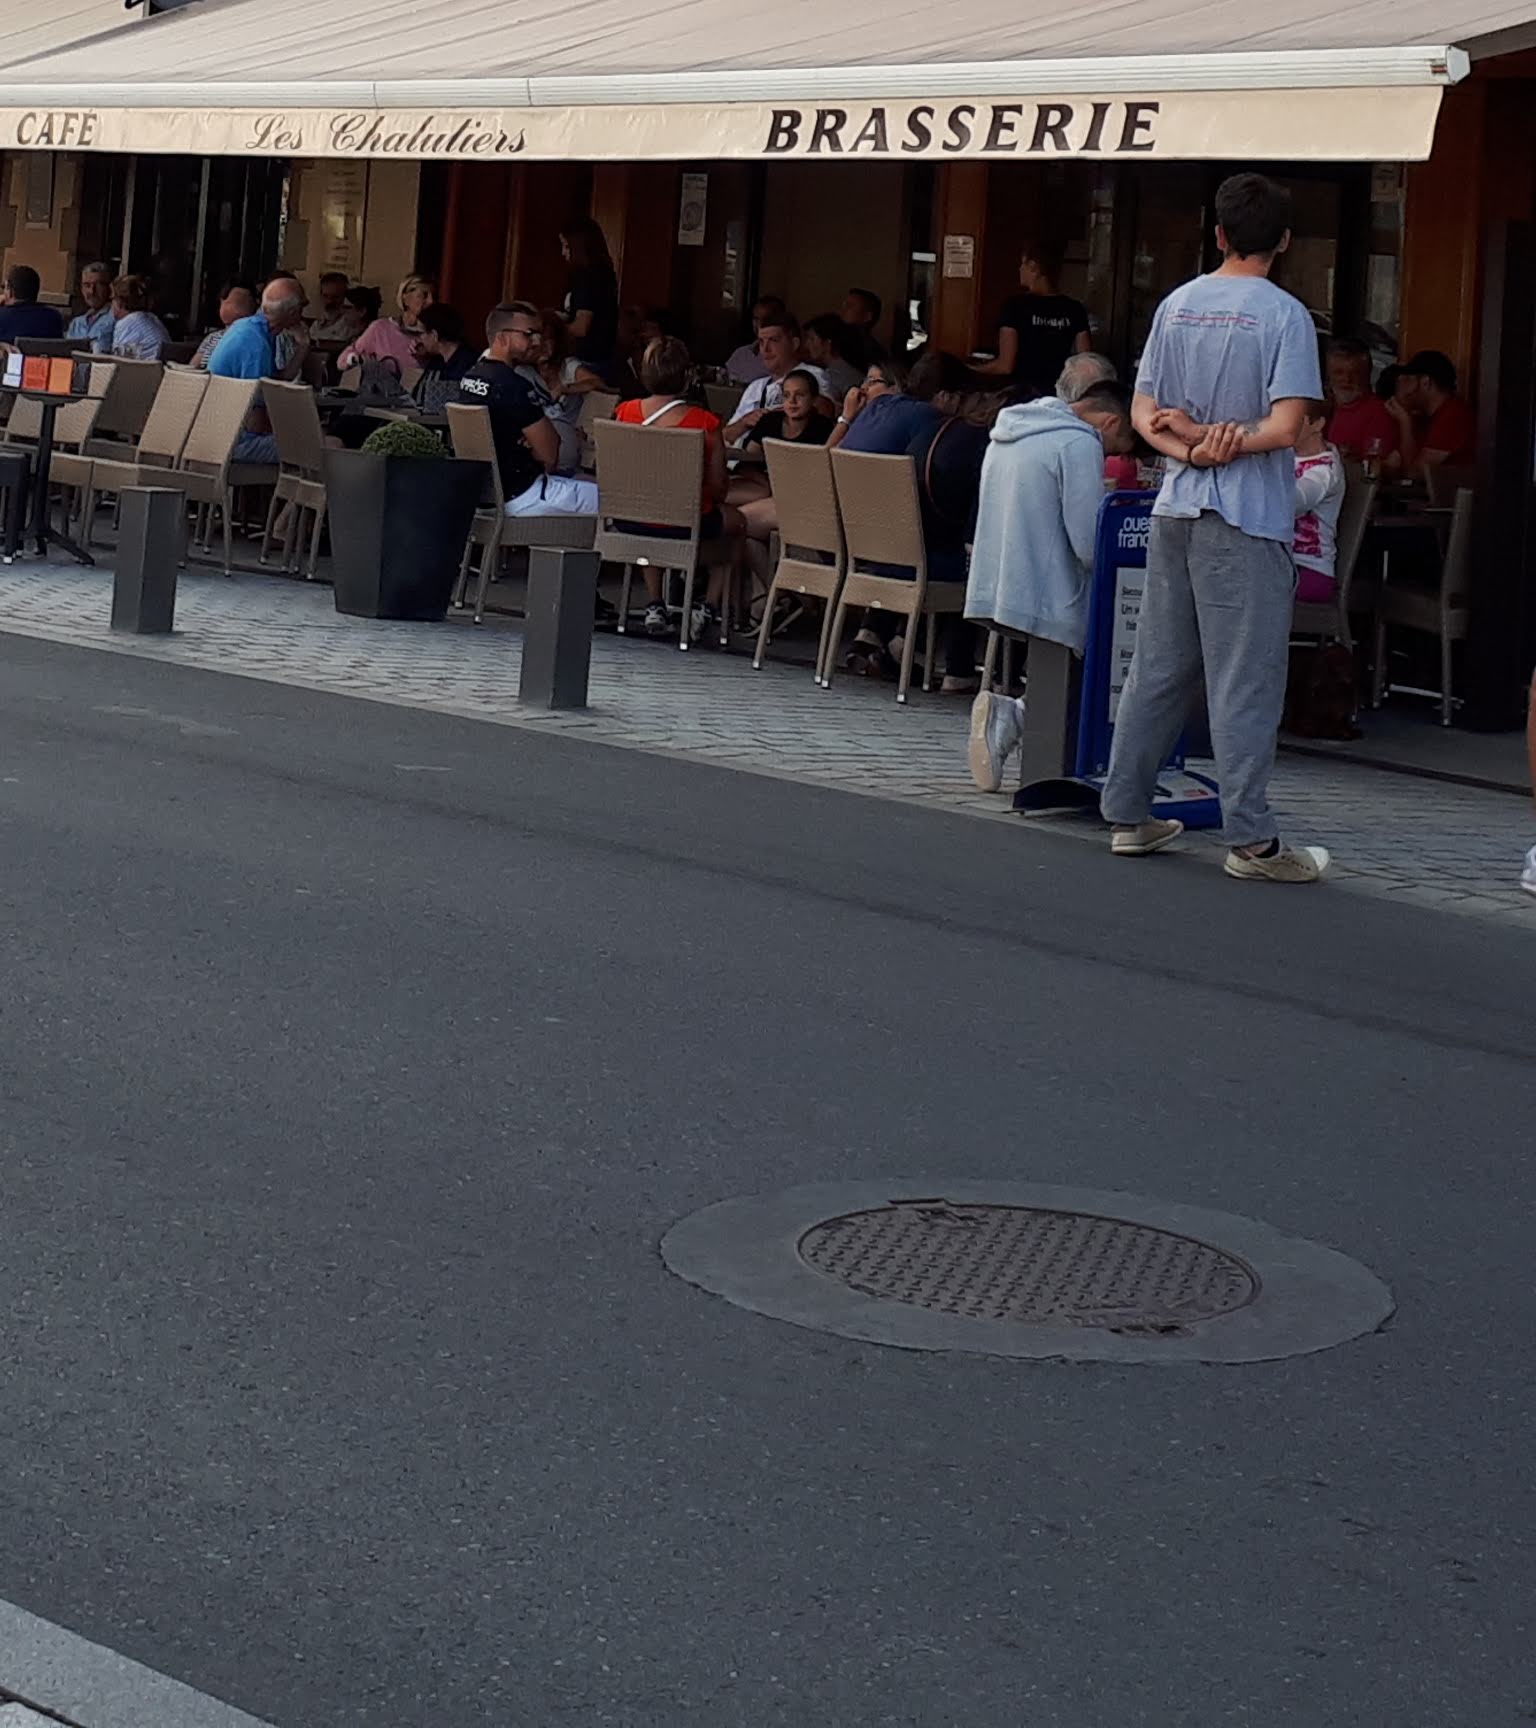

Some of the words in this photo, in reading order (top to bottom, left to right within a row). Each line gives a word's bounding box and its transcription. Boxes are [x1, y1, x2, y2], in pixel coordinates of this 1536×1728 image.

[16, 108, 98, 147] CAFÉ
[245, 114, 303, 151] Les
[329, 112, 528, 154] Chalutiers
[762, 101, 1160, 154] BRASSERIE
[1122, 516, 1153, 532] oues
[1116, 528, 1152, 549] franc
